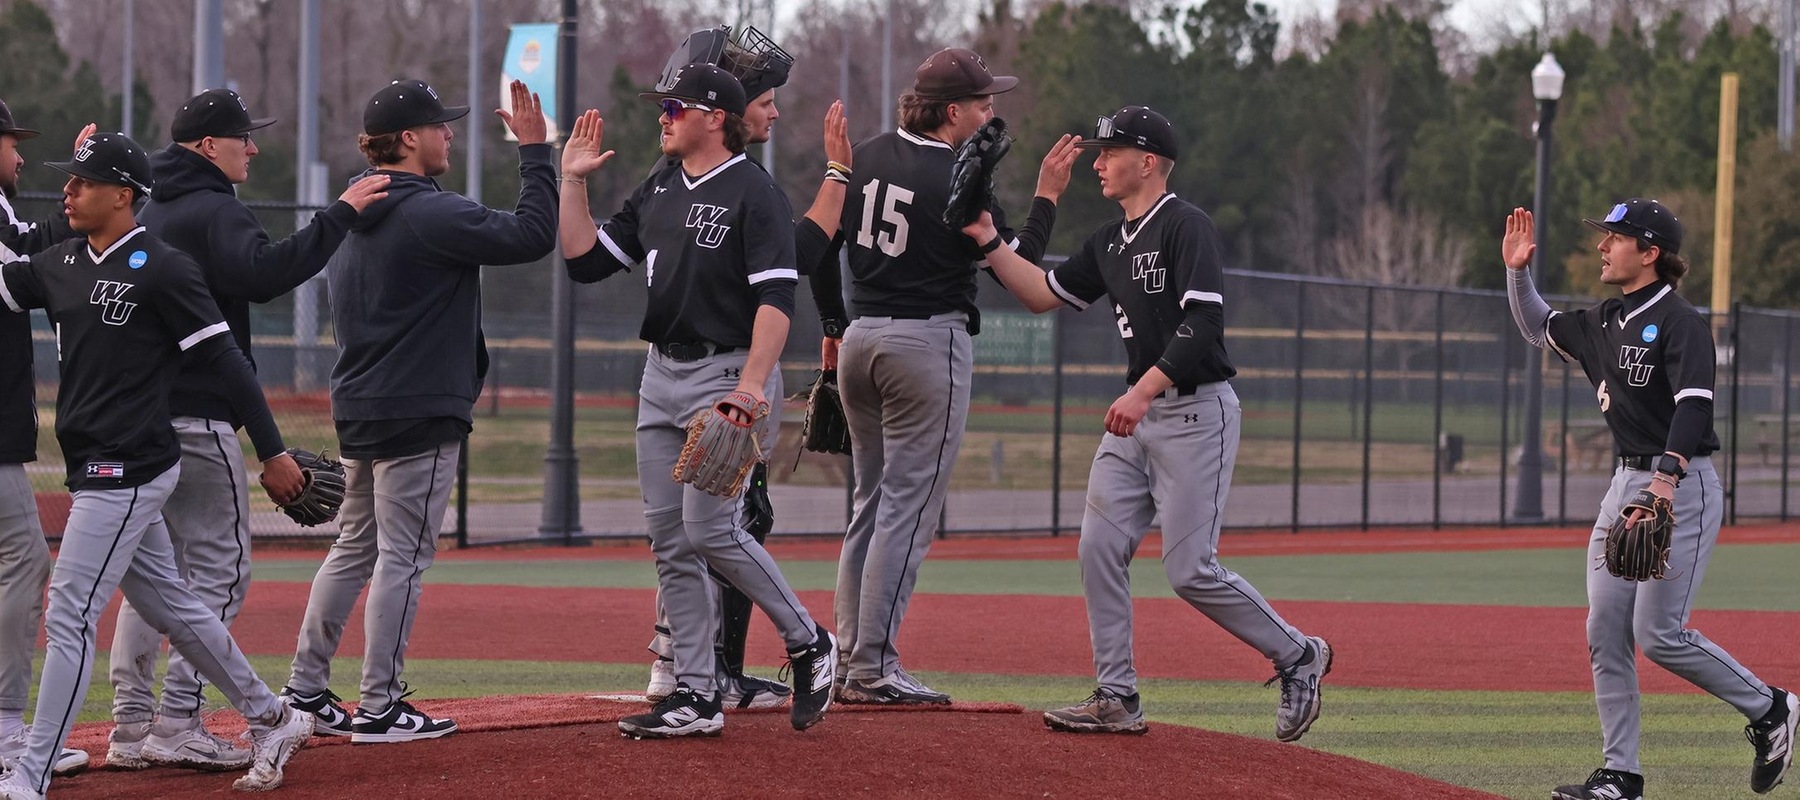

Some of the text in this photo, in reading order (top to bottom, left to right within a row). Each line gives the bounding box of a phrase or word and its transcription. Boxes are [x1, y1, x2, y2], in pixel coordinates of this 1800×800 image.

[685, 203, 732, 249] WU
[856, 177, 915, 258] 15
[1132, 251, 1166, 293] WU
[89, 279, 138, 326] WU
[1115, 303, 1134, 339] 2
[1619, 345, 1655, 387] WU
